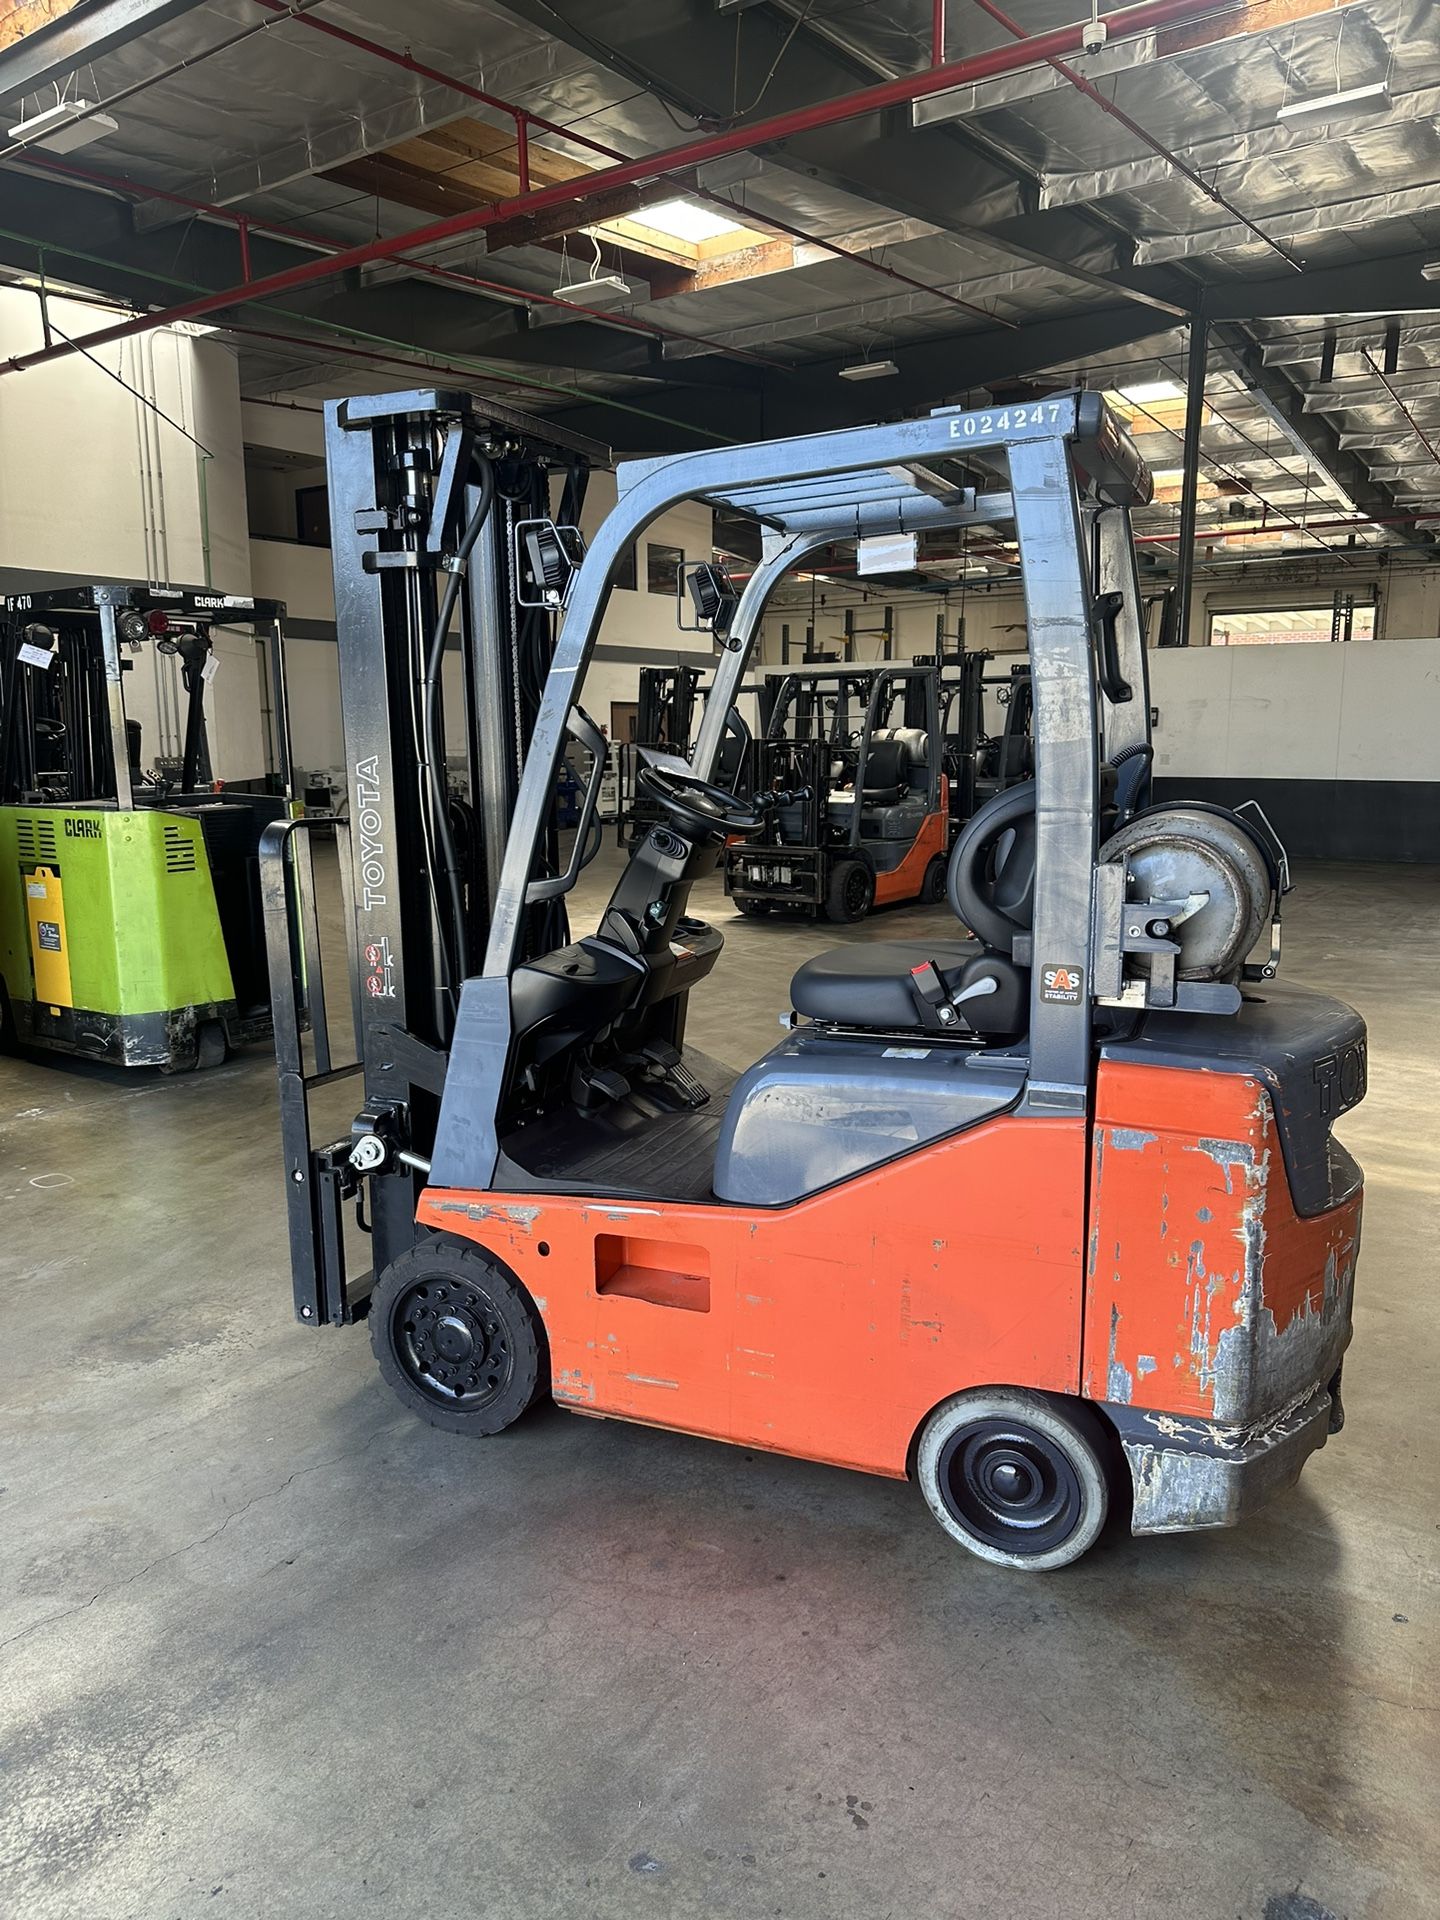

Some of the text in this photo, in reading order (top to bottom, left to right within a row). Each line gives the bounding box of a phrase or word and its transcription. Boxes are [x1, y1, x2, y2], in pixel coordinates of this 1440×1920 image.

[950, 404, 1060, 438] E024247
[194, 596, 226, 608] CLARK
[64, 818, 102, 838] CLARK
[356, 754, 386, 910] TOYOTA
[1044, 968, 1080, 990] SAS
